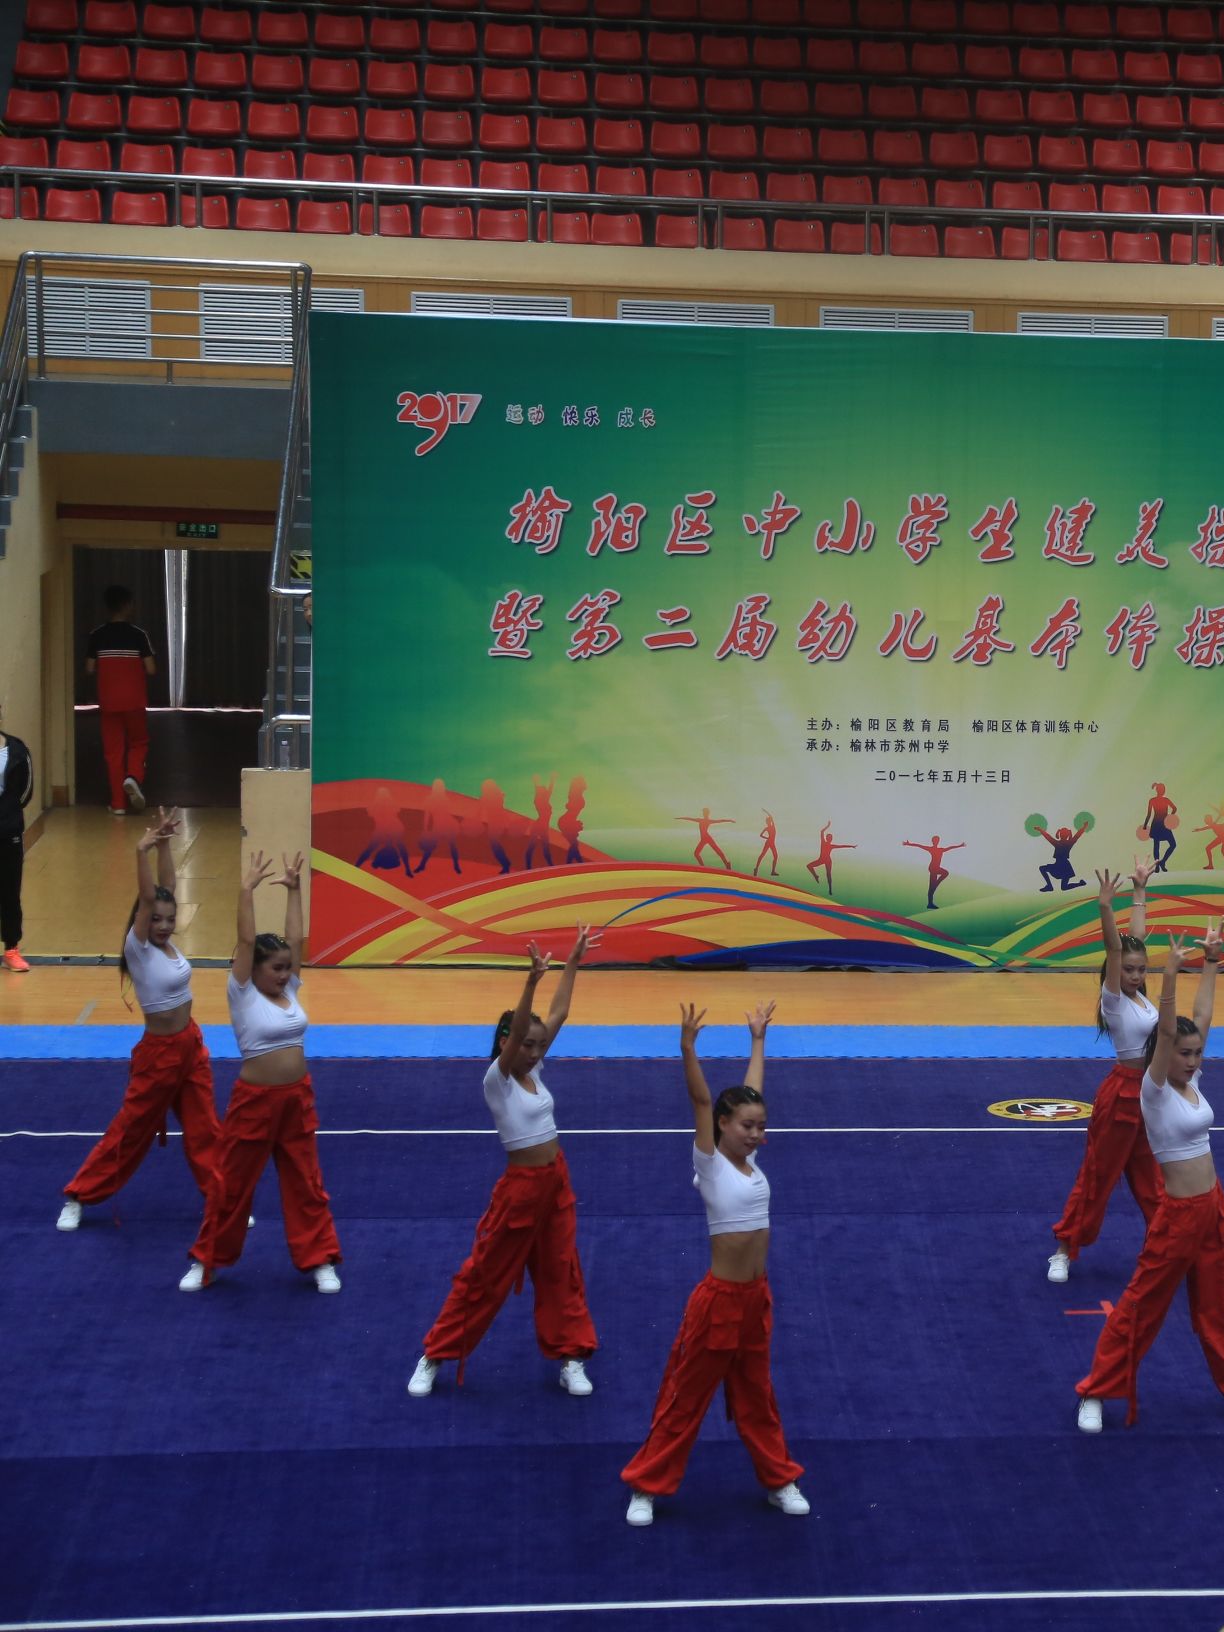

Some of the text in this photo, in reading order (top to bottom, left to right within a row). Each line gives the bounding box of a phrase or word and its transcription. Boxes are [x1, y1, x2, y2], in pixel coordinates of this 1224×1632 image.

[505, 404, 655, 428] 运动 快乐 成长
[971, 719, 1100, 734] 榆阳区体育训练中心
